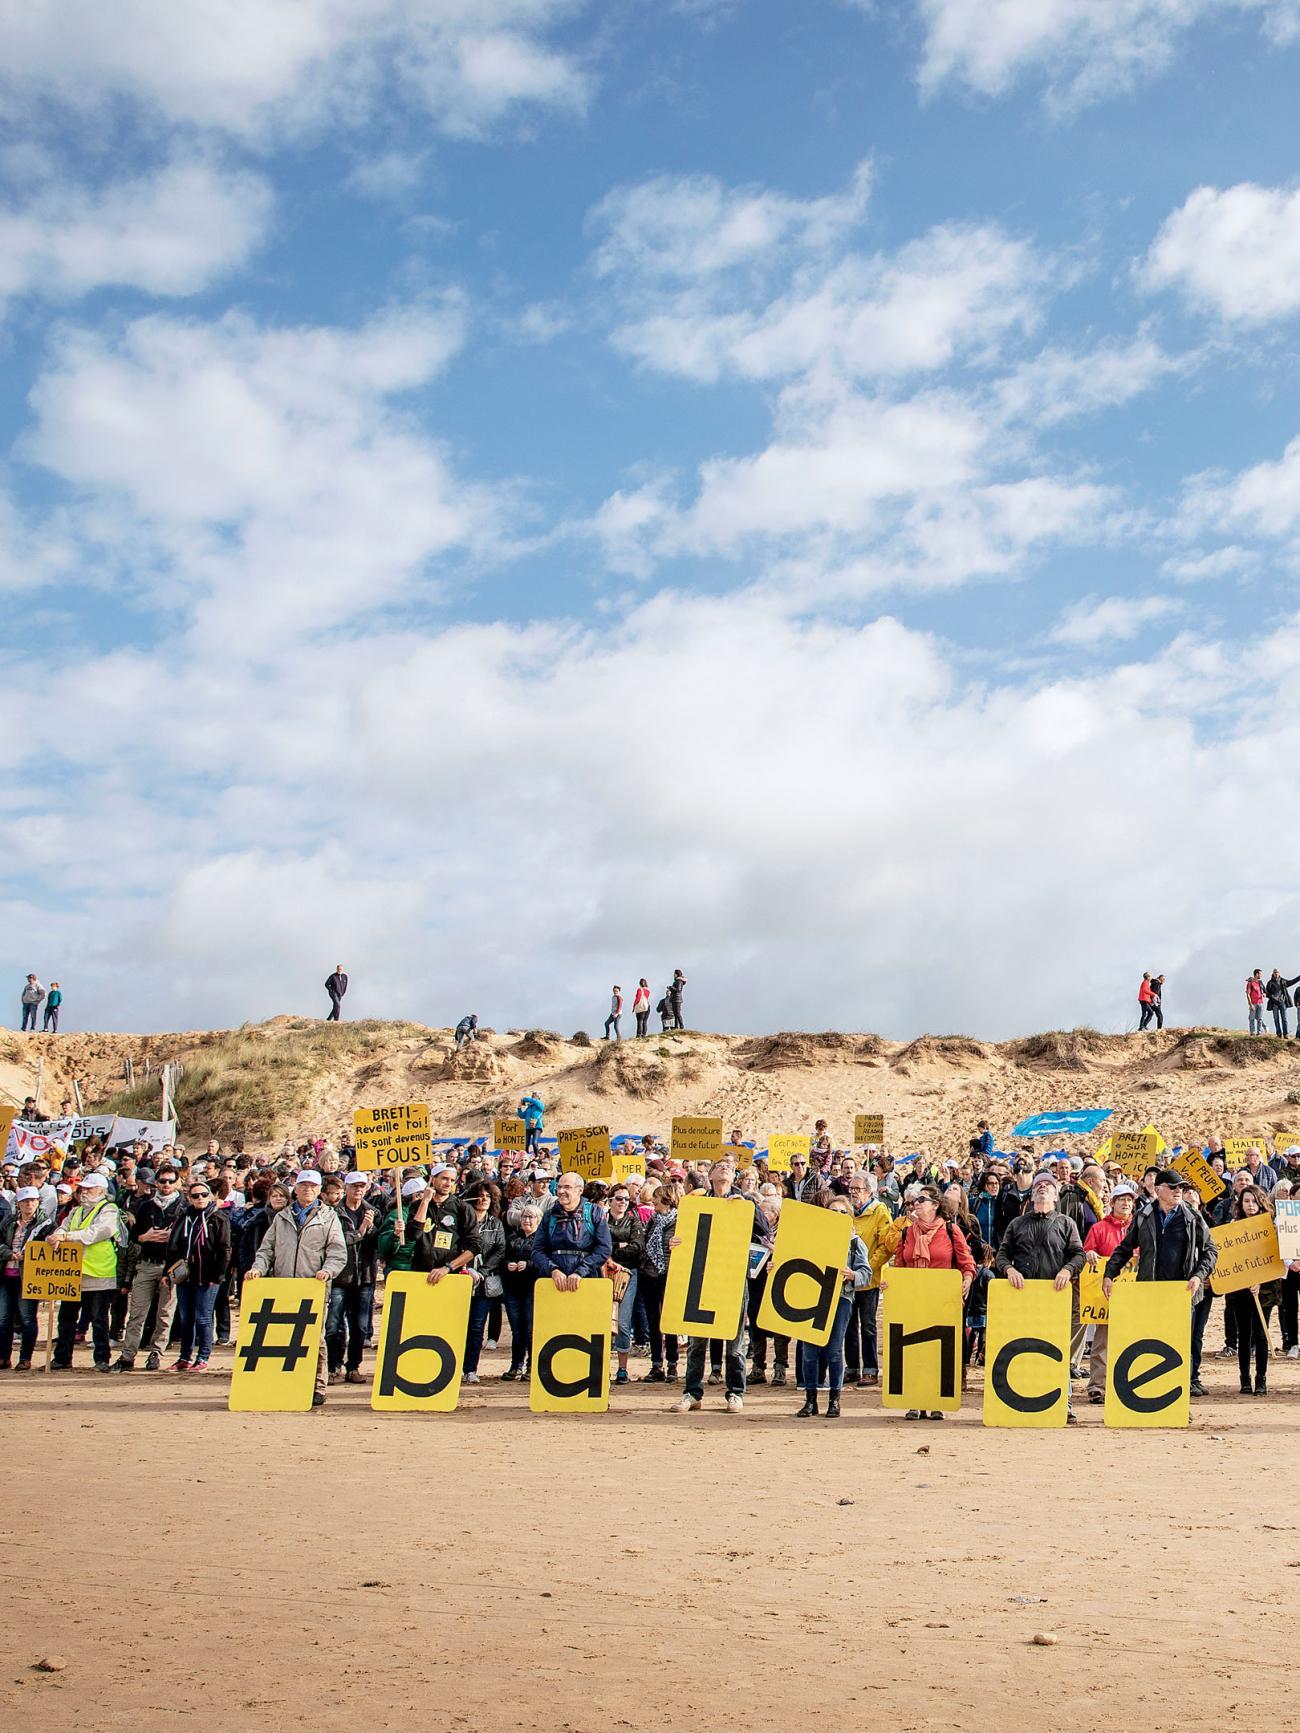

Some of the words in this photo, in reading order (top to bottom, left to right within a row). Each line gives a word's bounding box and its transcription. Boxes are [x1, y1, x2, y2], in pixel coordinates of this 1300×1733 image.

[501, 1122, 519, 1132] Port
[673, 1125, 687, 1134] Plus
[371, 1135, 393, 1147] sont
[394, 1132, 430, 1143] devenus
[503, 1136, 525, 1144] HONTE
[559, 1131, 578, 1143] PAYS
[672, 1139, 687, 1148] Plus
[576, 1141, 587, 1153] LA
[1232, 1141, 1261, 1149] HALTE
[377, 1147, 421, 1165] FOUS
[1115, 1151, 1149, 1161] HONTE
[622, 1165, 642, 1173] MER
[1185, 1152, 1200, 1167] LE
[1197, 1165, 1223, 1194] PEUPLE
[1224, 1237, 1233, 1248] de
[1235, 1229, 1269, 1245] nature
[30, 1246, 46, 1261] LA
[52, 1246, 78, 1263] MER
[1212, 1267, 1231, 1279] Plus
[1233, 1262, 1243, 1273] de
[1245, 1254, 1274, 1270] futur
[27, 1283, 42, 1294] Ses
[772, 1259, 838, 1331] a
[538, 1335, 604, 1397] a
[889, 1323, 955, 1397] n
[1114, 1340, 1182, 1413] e
